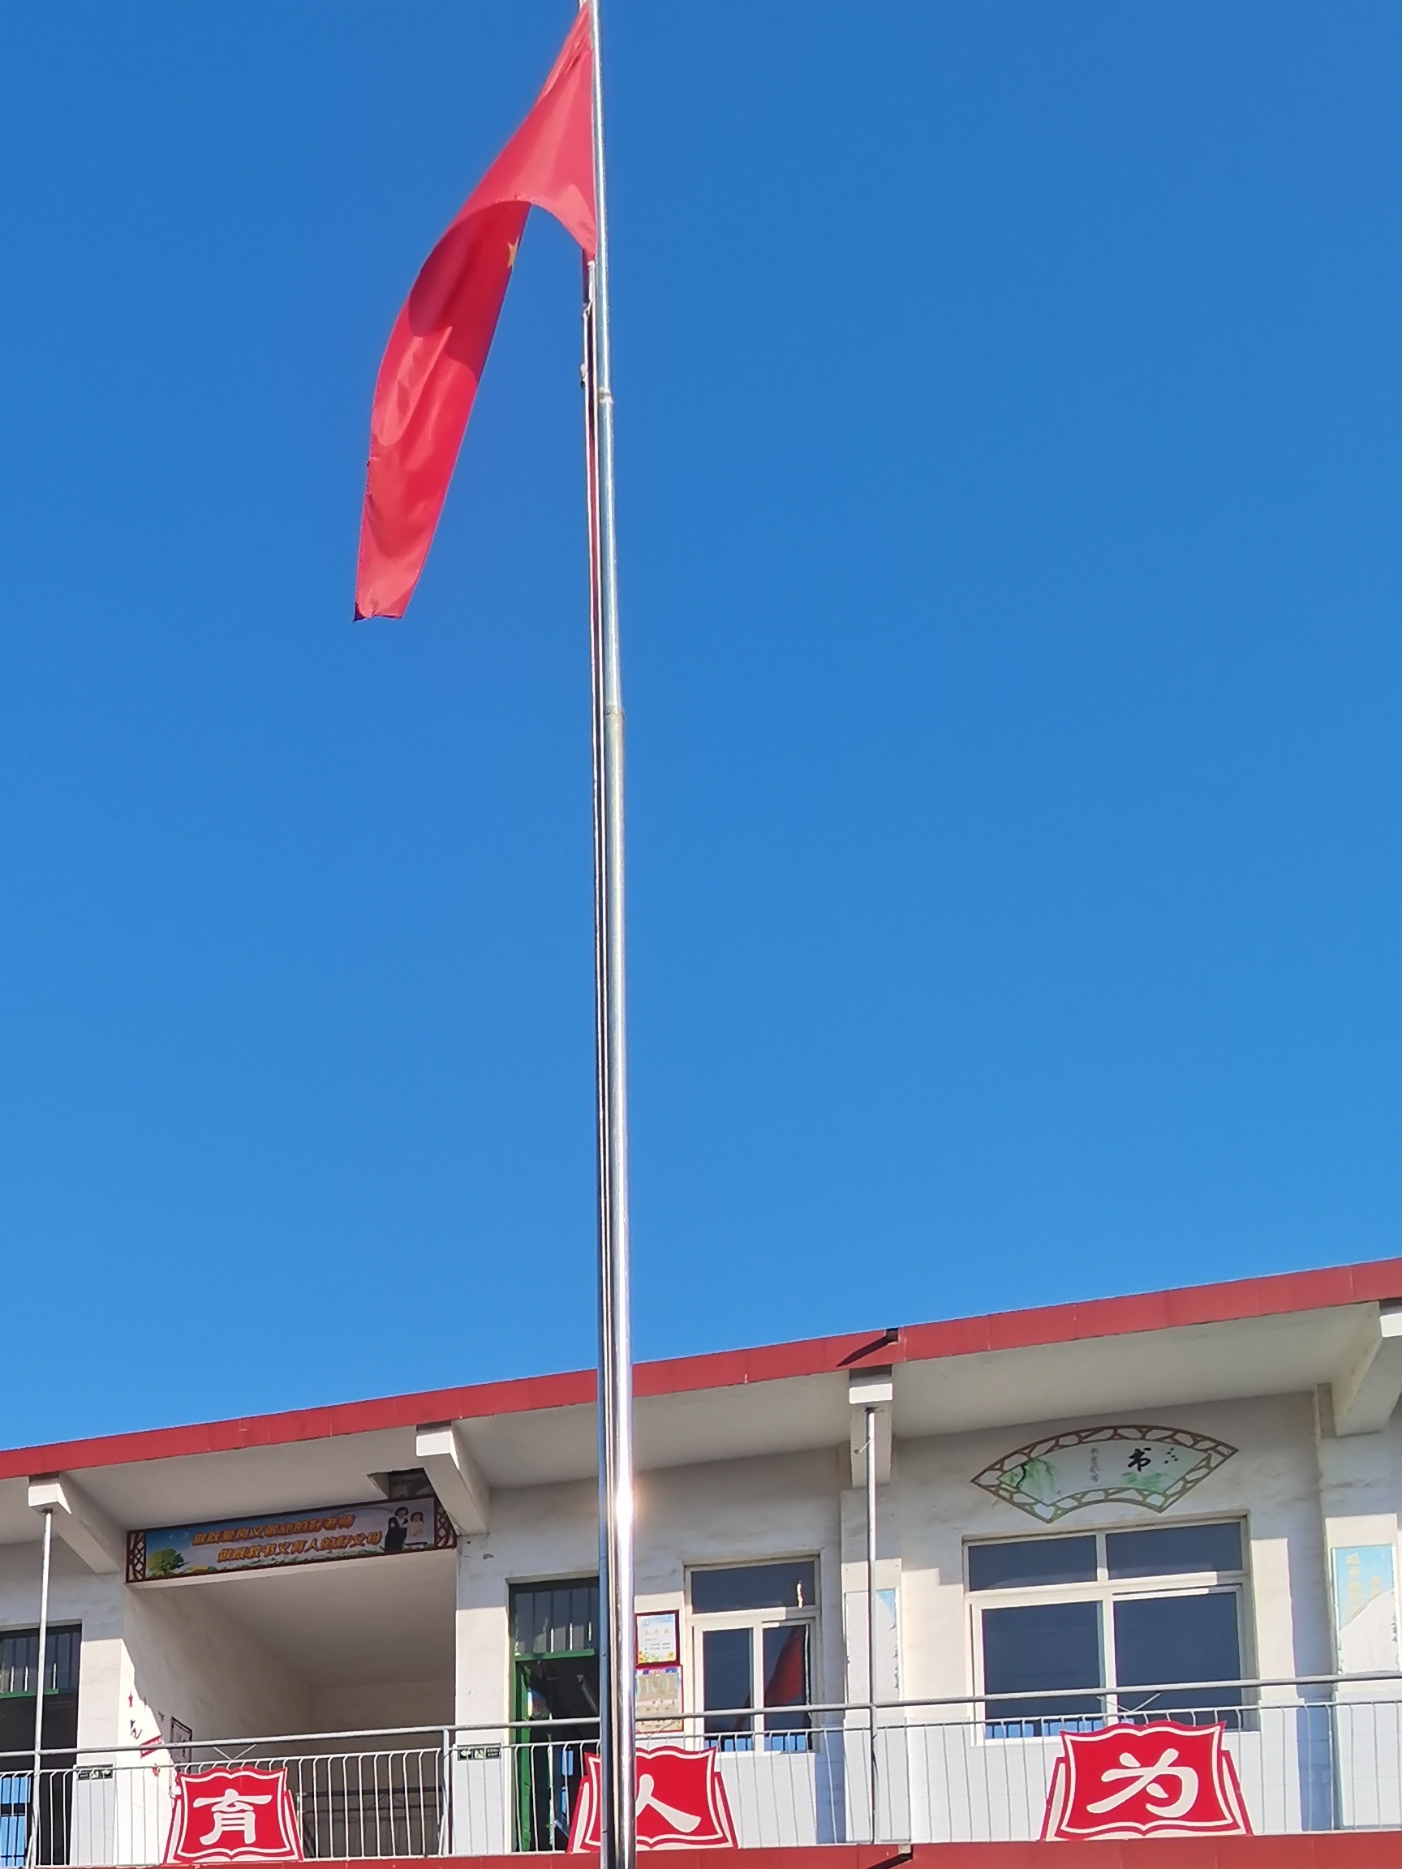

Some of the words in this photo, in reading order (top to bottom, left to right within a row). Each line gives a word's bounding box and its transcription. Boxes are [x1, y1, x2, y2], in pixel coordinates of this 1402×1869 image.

[635, 1774, 701, 1832] 人
[1086, 1748, 1198, 1818] 为
[192, 1789, 272, 1845] 育
